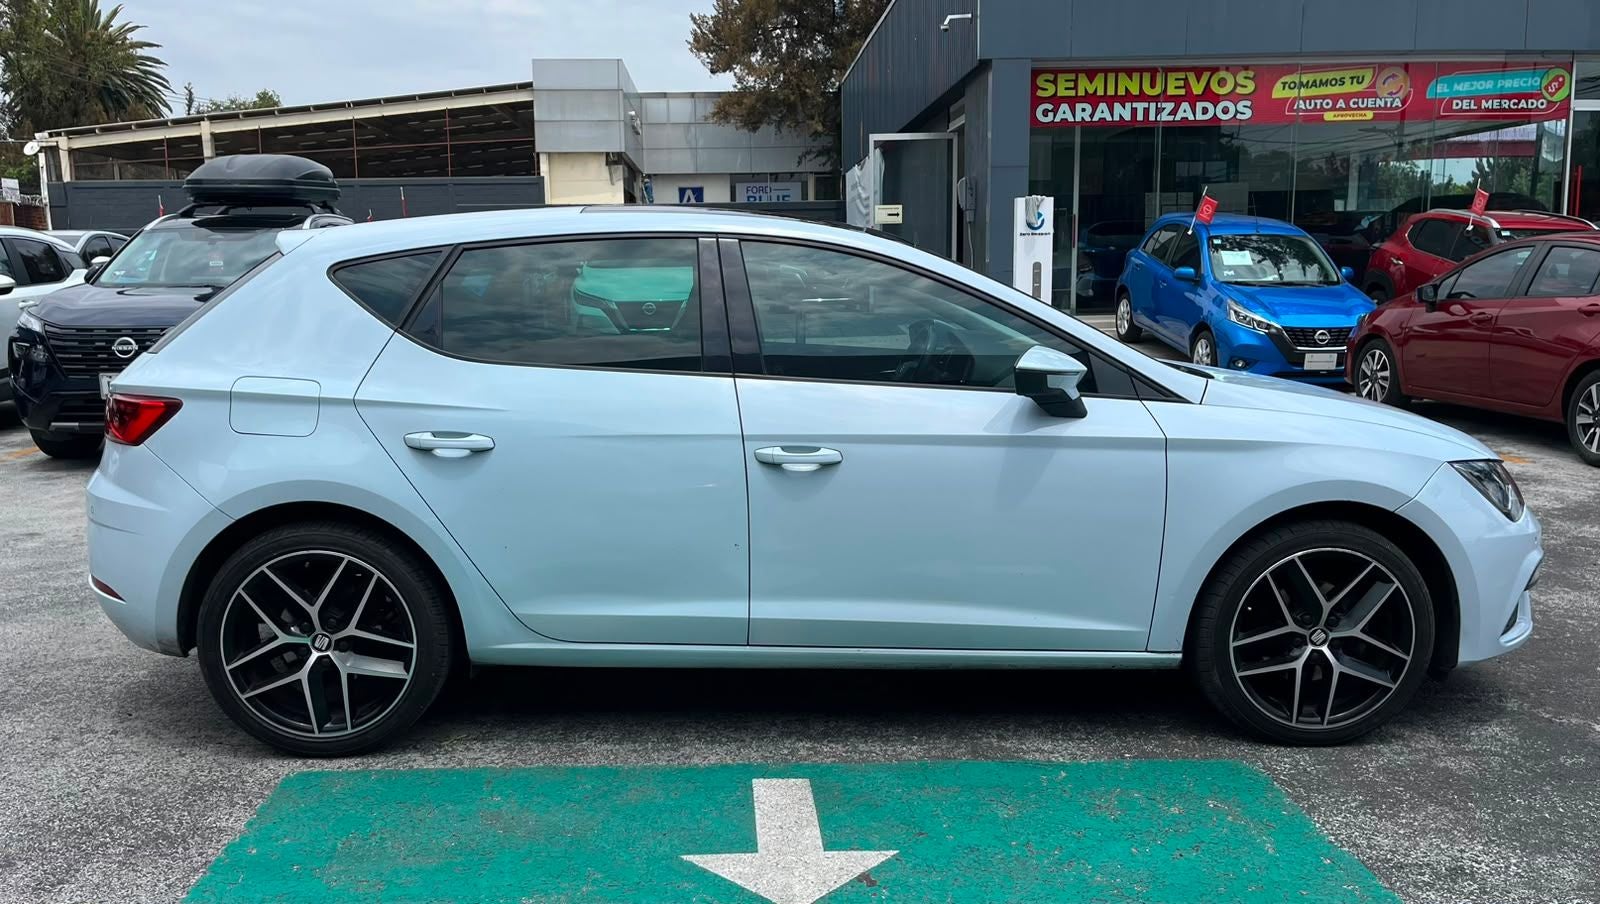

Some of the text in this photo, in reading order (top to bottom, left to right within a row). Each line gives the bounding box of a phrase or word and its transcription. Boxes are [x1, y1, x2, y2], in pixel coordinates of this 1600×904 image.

[1036, 71, 1256, 97] SEMINUEVOS
[1281, 75, 1365, 90] TOMAMOS TU
[1437, 77, 1540, 92] EL MEJOR PRECIO
[1294, 97, 1402, 110] AUTO A CUENTA
[1452, 98, 1547, 110] DEL MERCADO
[1035, 101, 1253, 122] GARANTIZADOS
[746, 186, 772, 194] FORD
